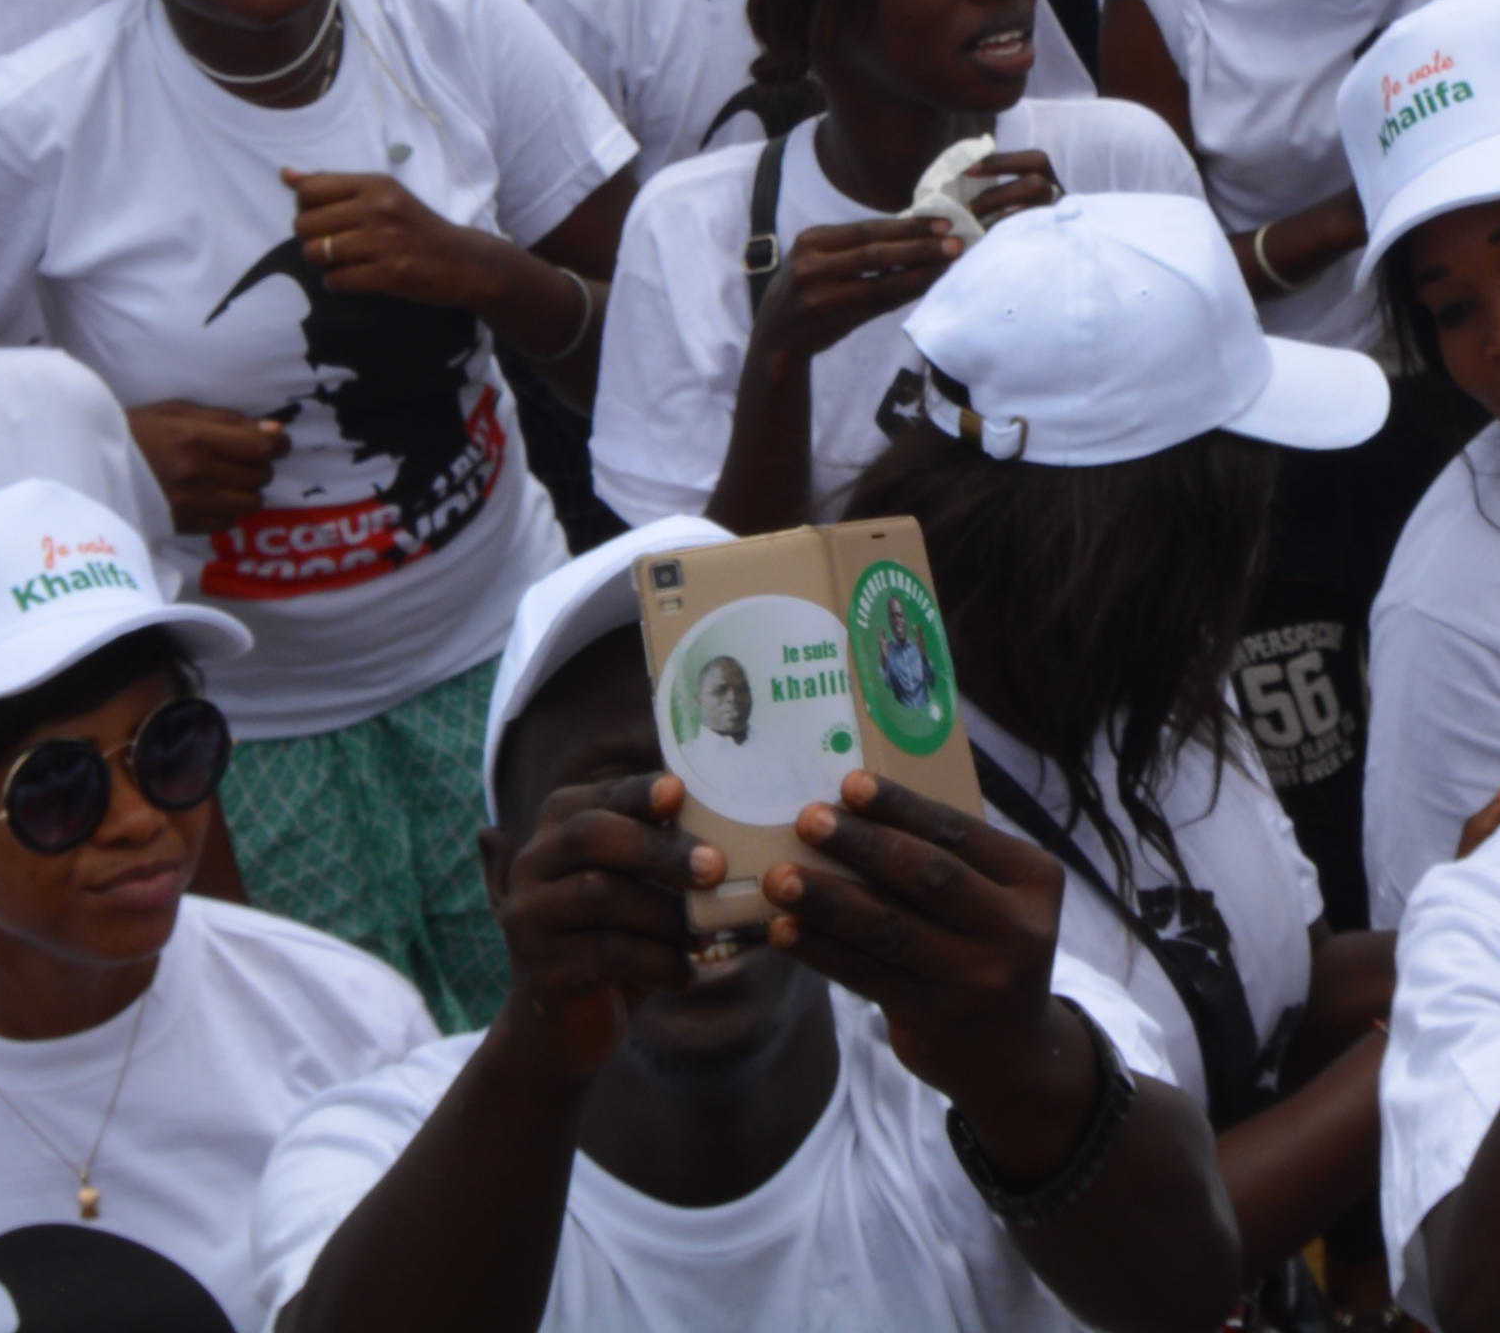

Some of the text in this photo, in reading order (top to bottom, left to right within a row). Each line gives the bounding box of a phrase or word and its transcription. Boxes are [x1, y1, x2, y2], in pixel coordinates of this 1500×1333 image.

[1378, 48, 1457, 112] Je vote
[1378, 74, 1476, 158] Khalifa
[10, 558, 142, 614] Khalifa
[782, 640, 838, 664] Je suis
[770, 670, 851, 703] khalif
[1241, 650, 1340, 749] 56
